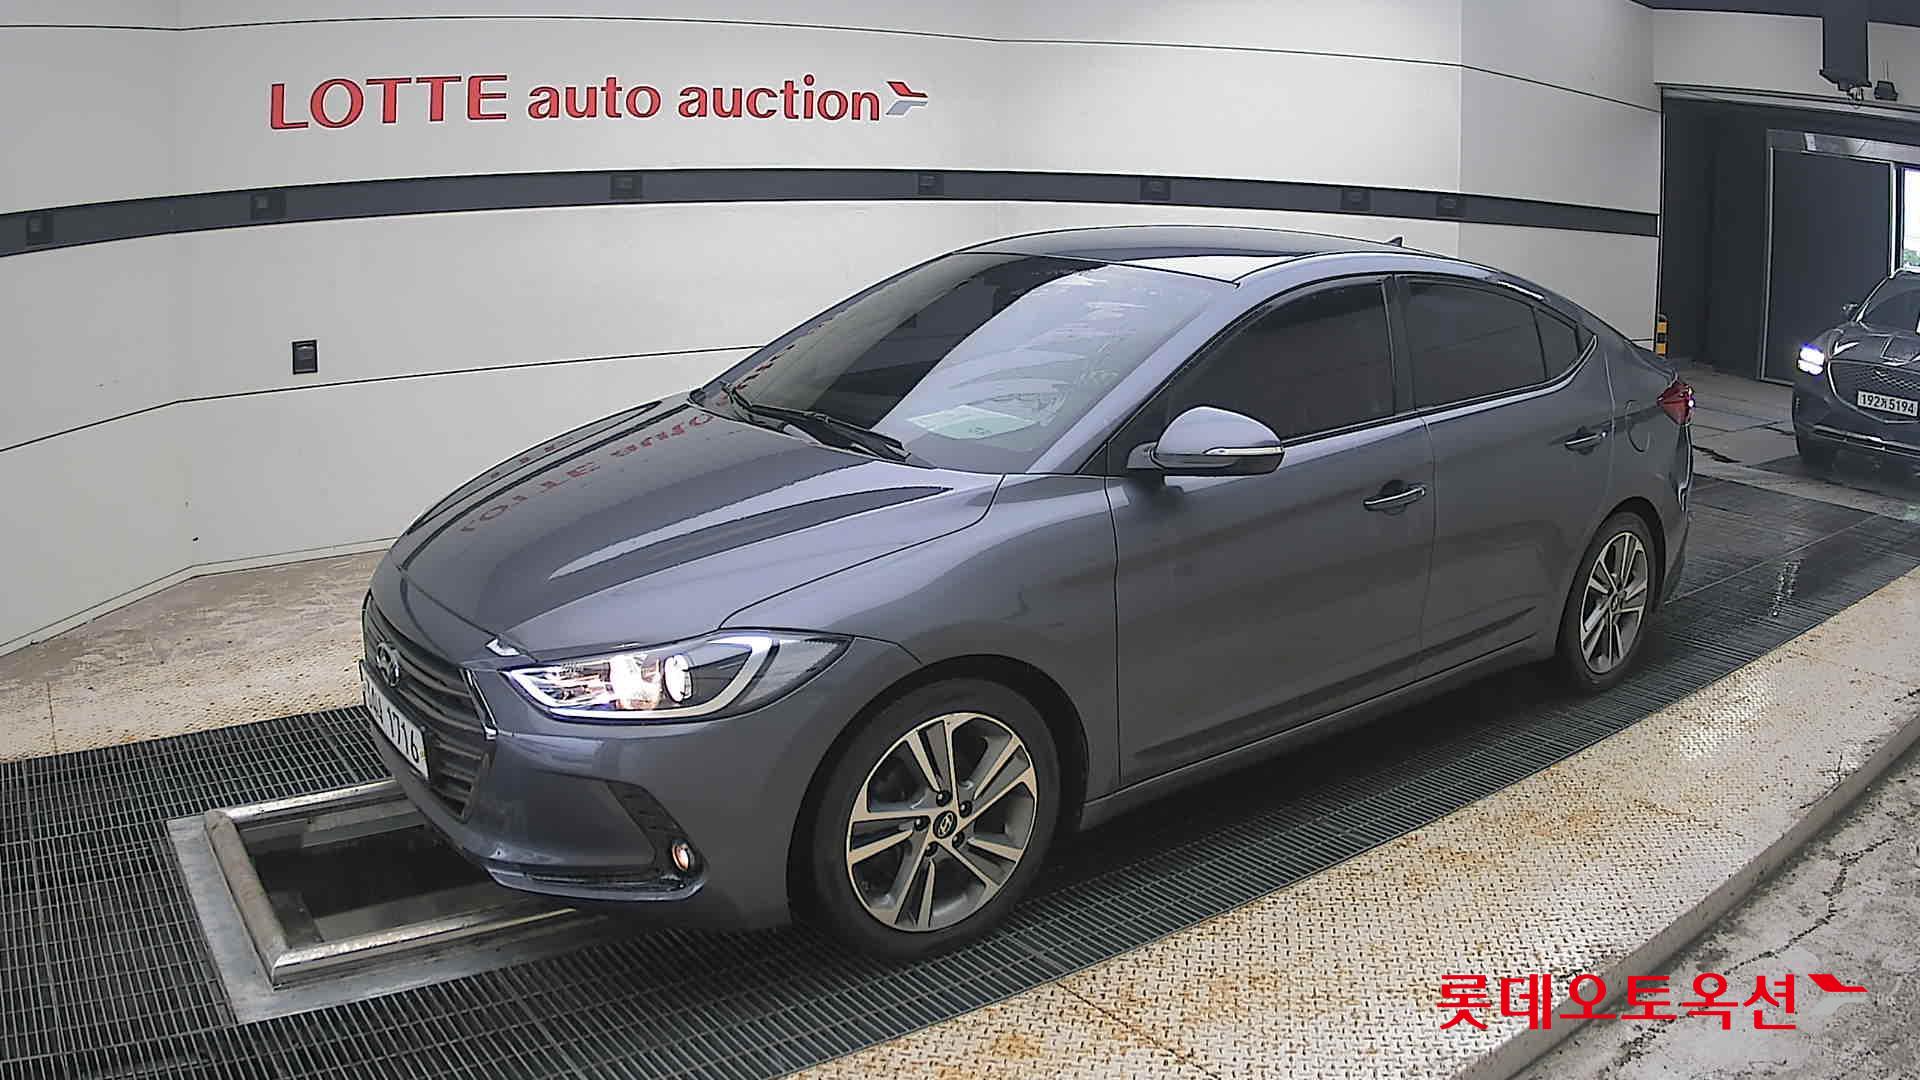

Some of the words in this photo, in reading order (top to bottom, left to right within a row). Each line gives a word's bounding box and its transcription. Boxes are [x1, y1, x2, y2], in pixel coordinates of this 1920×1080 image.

[269, 74, 508, 130] LOTTE
[527, 76, 662, 120] auto
[678, 75, 881, 121] auction
[387, 706, 419, 763] 1716
